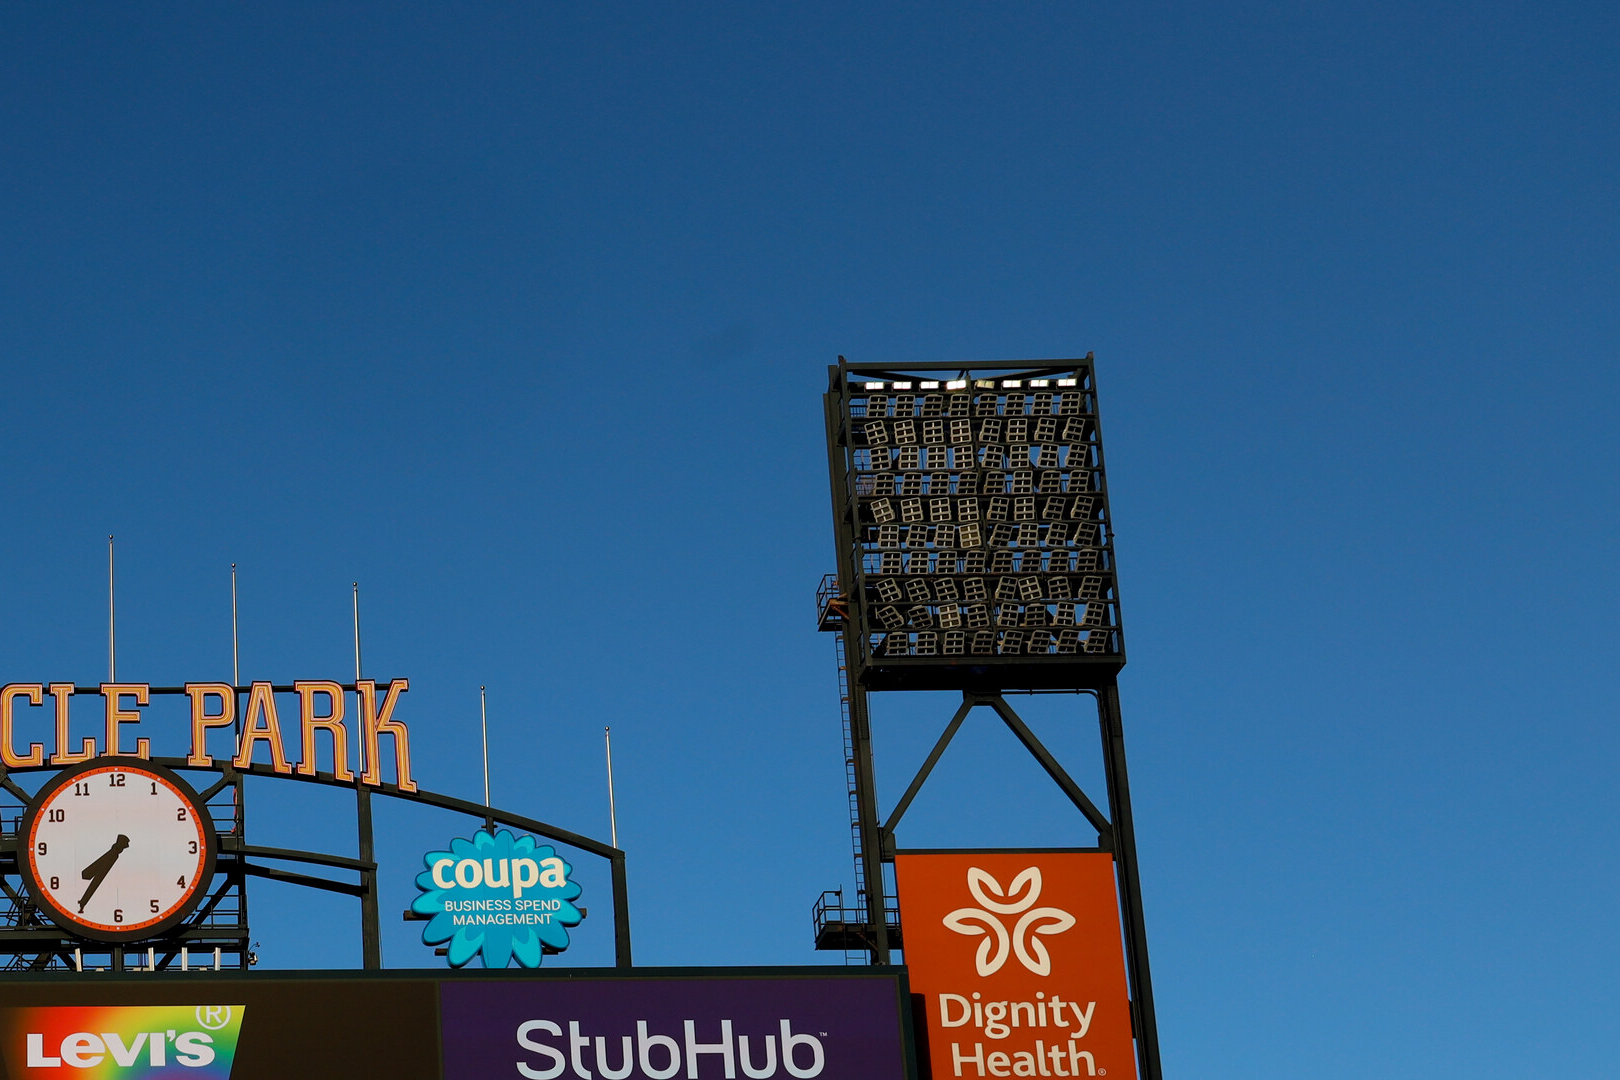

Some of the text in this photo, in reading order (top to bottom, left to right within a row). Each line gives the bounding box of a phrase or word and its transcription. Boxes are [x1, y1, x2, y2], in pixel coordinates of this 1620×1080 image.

[184, 679, 418, 794] PARK
[109, 774, 125, 787] 12
[75, 783, 90, 796] 11
[150, 782, 158, 795] 1
[49, 809, 65, 822] 10
[177, 808, 187, 821] 2
[38, 842, 47, 855] 9
[188, 841, 197, 854] 3
[50, 876, 59, 890] 8
[177, 875, 186, 888] 4
[432, 857, 567, 899] coupa
[150, 900, 160, 913] 5
[445, 899, 561, 912] BUSINESS SPEND
[114, 909, 123, 923] 6
[453, 913, 553, 926] MANAGEMENT
[938, 991, 1097, 1039] Dignity
[516, 1019, 826, 1080] StubHub
[951, 1040, 1097, 1077] Health
